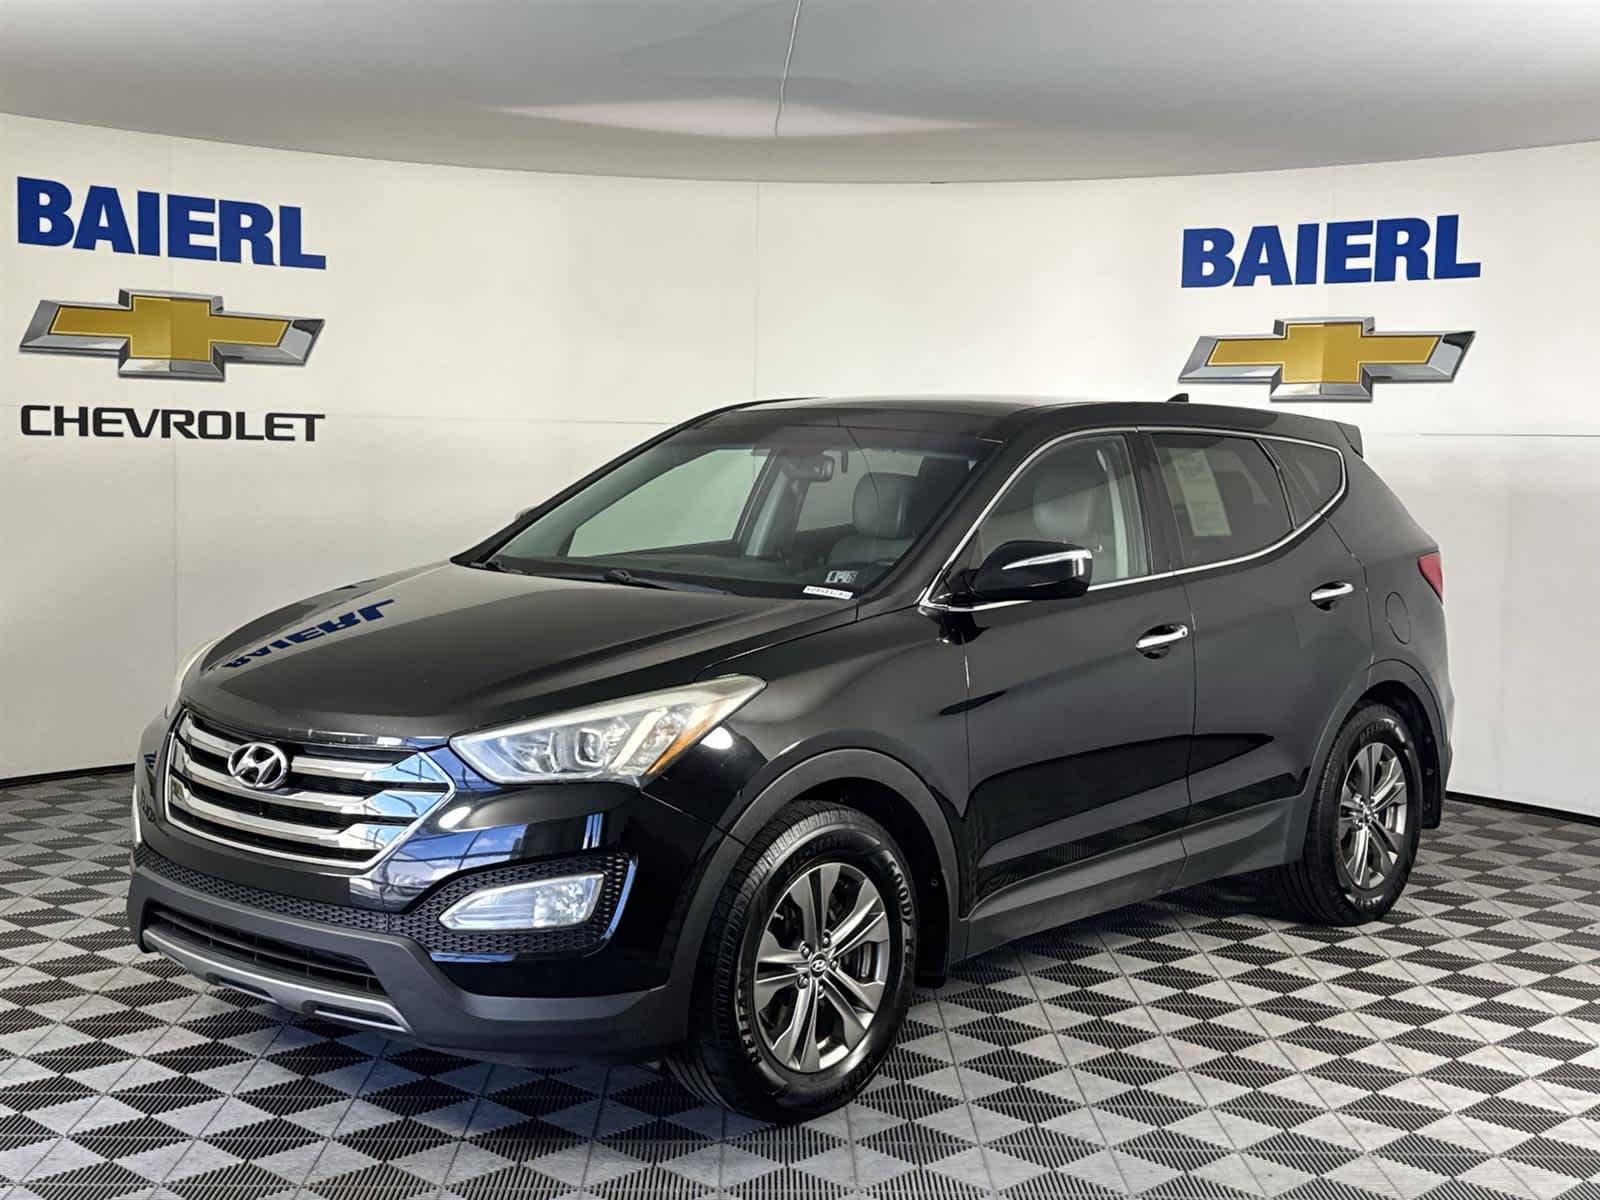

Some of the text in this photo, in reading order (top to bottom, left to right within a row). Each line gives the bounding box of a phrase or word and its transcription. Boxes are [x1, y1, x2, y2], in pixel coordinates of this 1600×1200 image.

[17, 176, 327, 270] BAIERL
[1181, 214, 1481, 288] BAIERL
[20, 405, 326, 442] CHEVROLET
